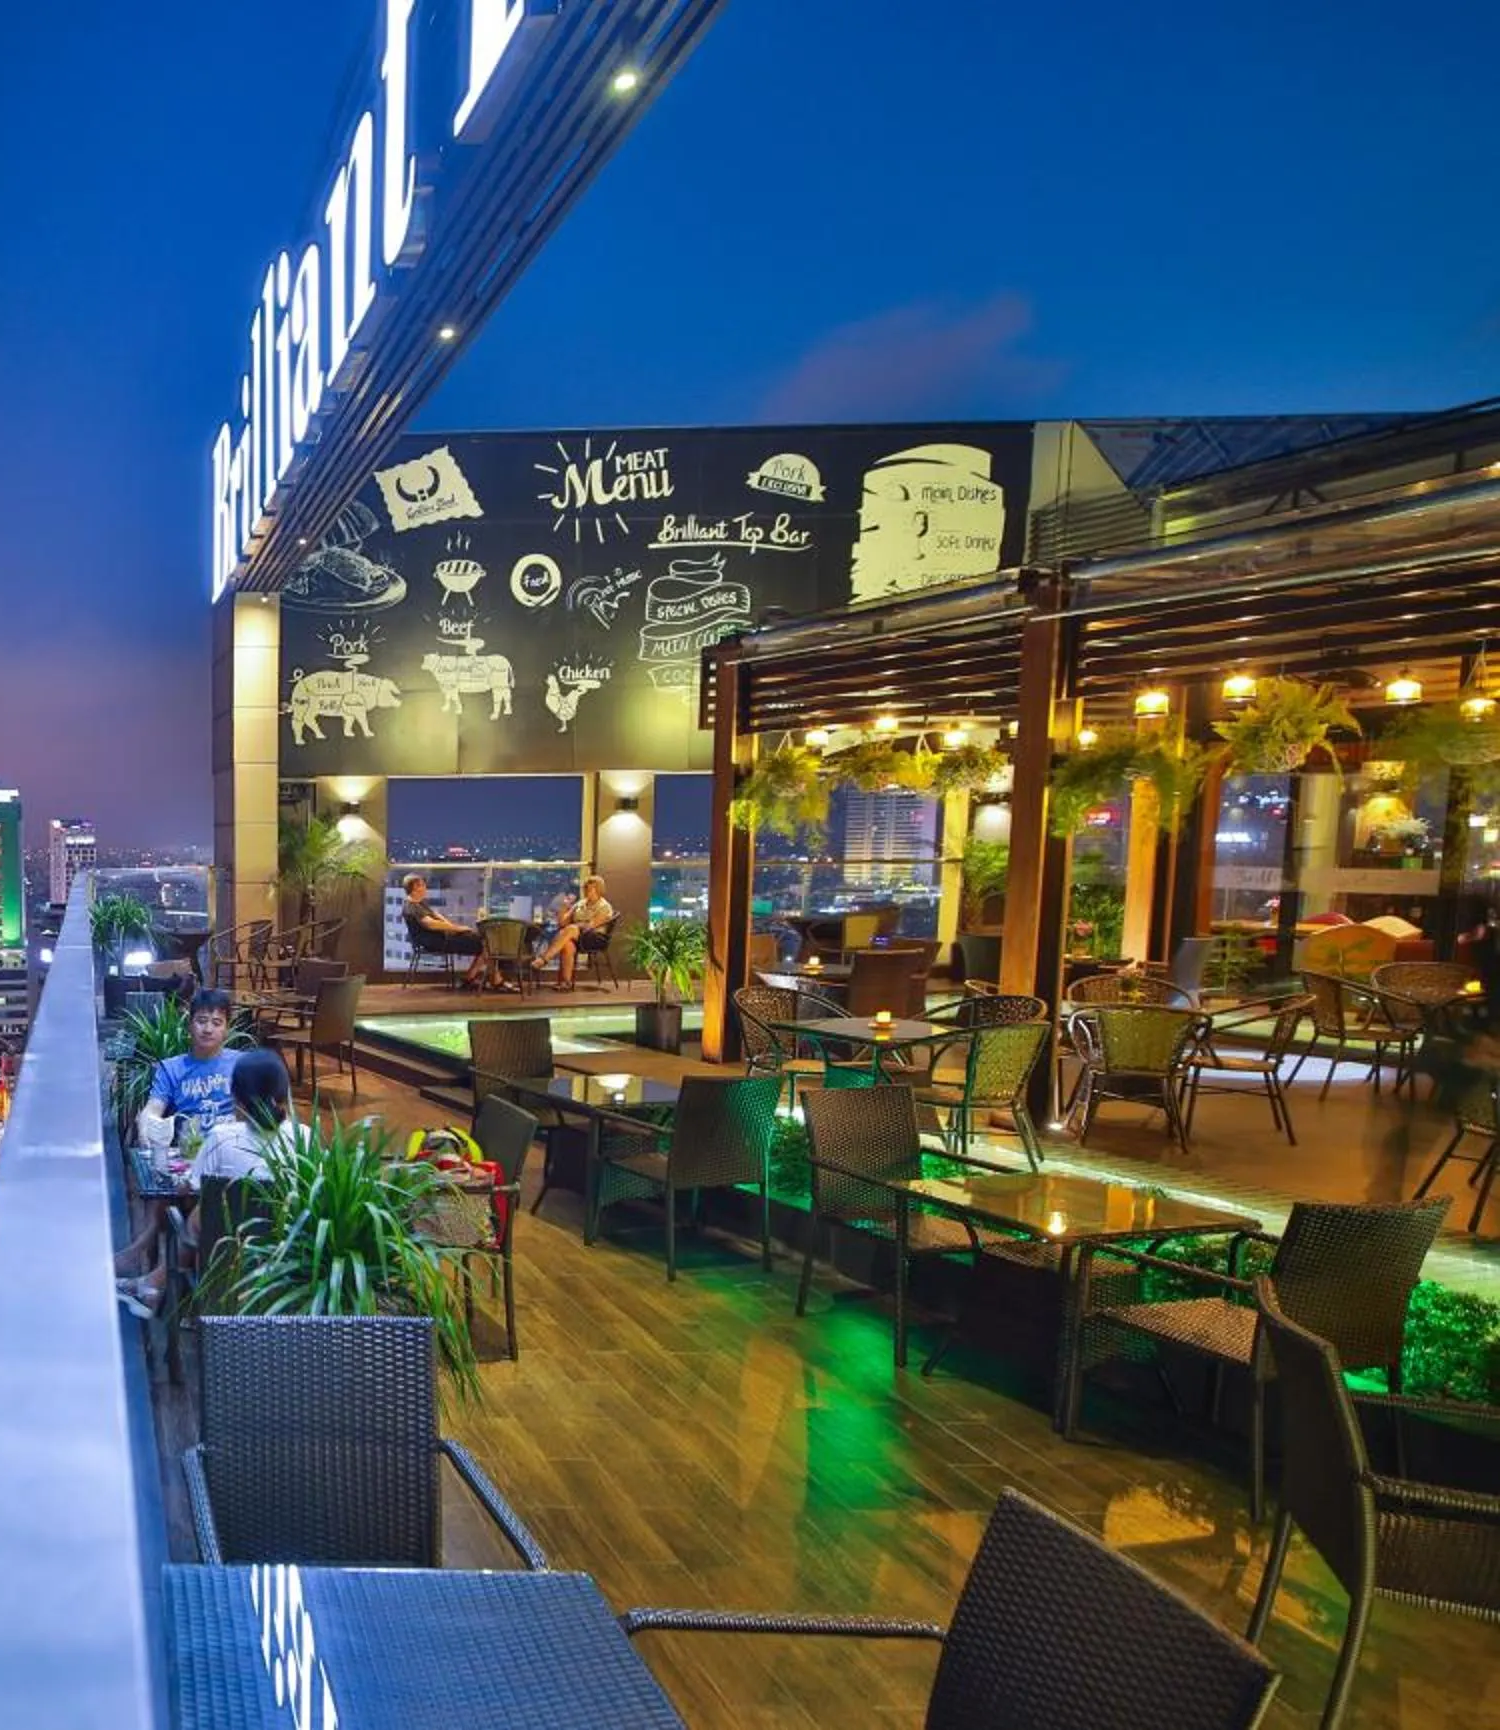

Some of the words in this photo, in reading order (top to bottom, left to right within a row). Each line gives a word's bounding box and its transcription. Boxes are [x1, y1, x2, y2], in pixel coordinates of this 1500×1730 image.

[615, 448, 668, 473] MEAT
[551, 459, 675, 510] Menu
[657, 514, 728, 544] Brilliant
[732, 511, 764, 554] Top
[769, 512, 811, 545] Bar
[439, 618, 476, 640] Beef
[329, 633, 369, 655] Pork
[558, 664, 611, 680] Chicken
